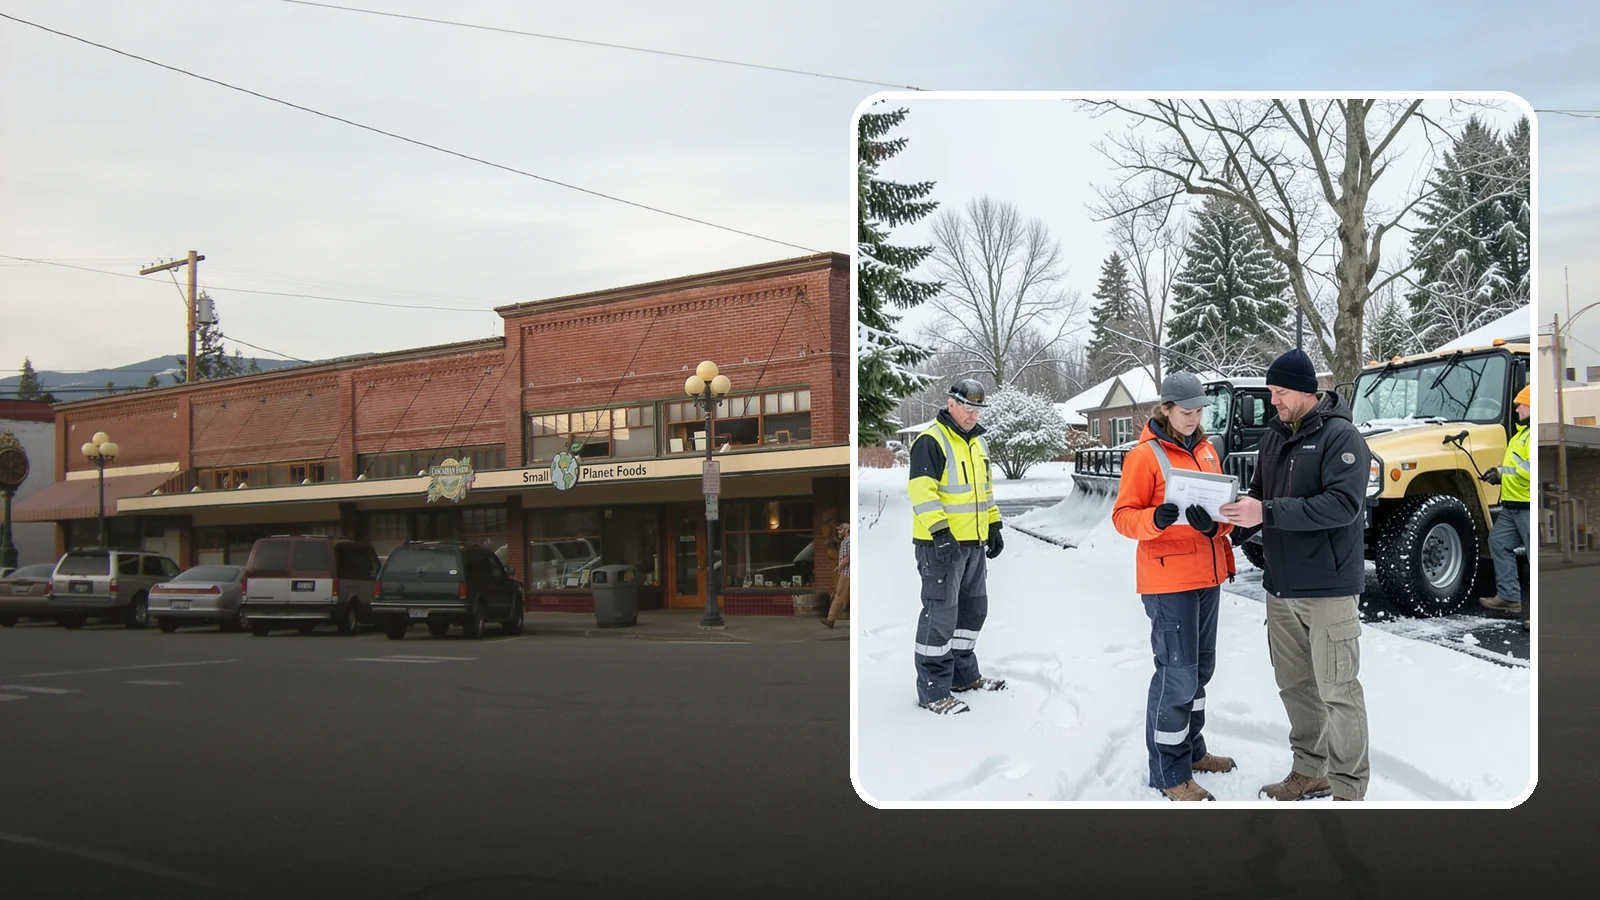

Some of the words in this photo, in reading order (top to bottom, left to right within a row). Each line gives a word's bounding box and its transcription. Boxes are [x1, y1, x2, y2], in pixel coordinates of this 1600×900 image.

[523, 471, 549, 482] Small
[583, 468, 614, 479] Planet
[617, 464, 647, 477] Foods
